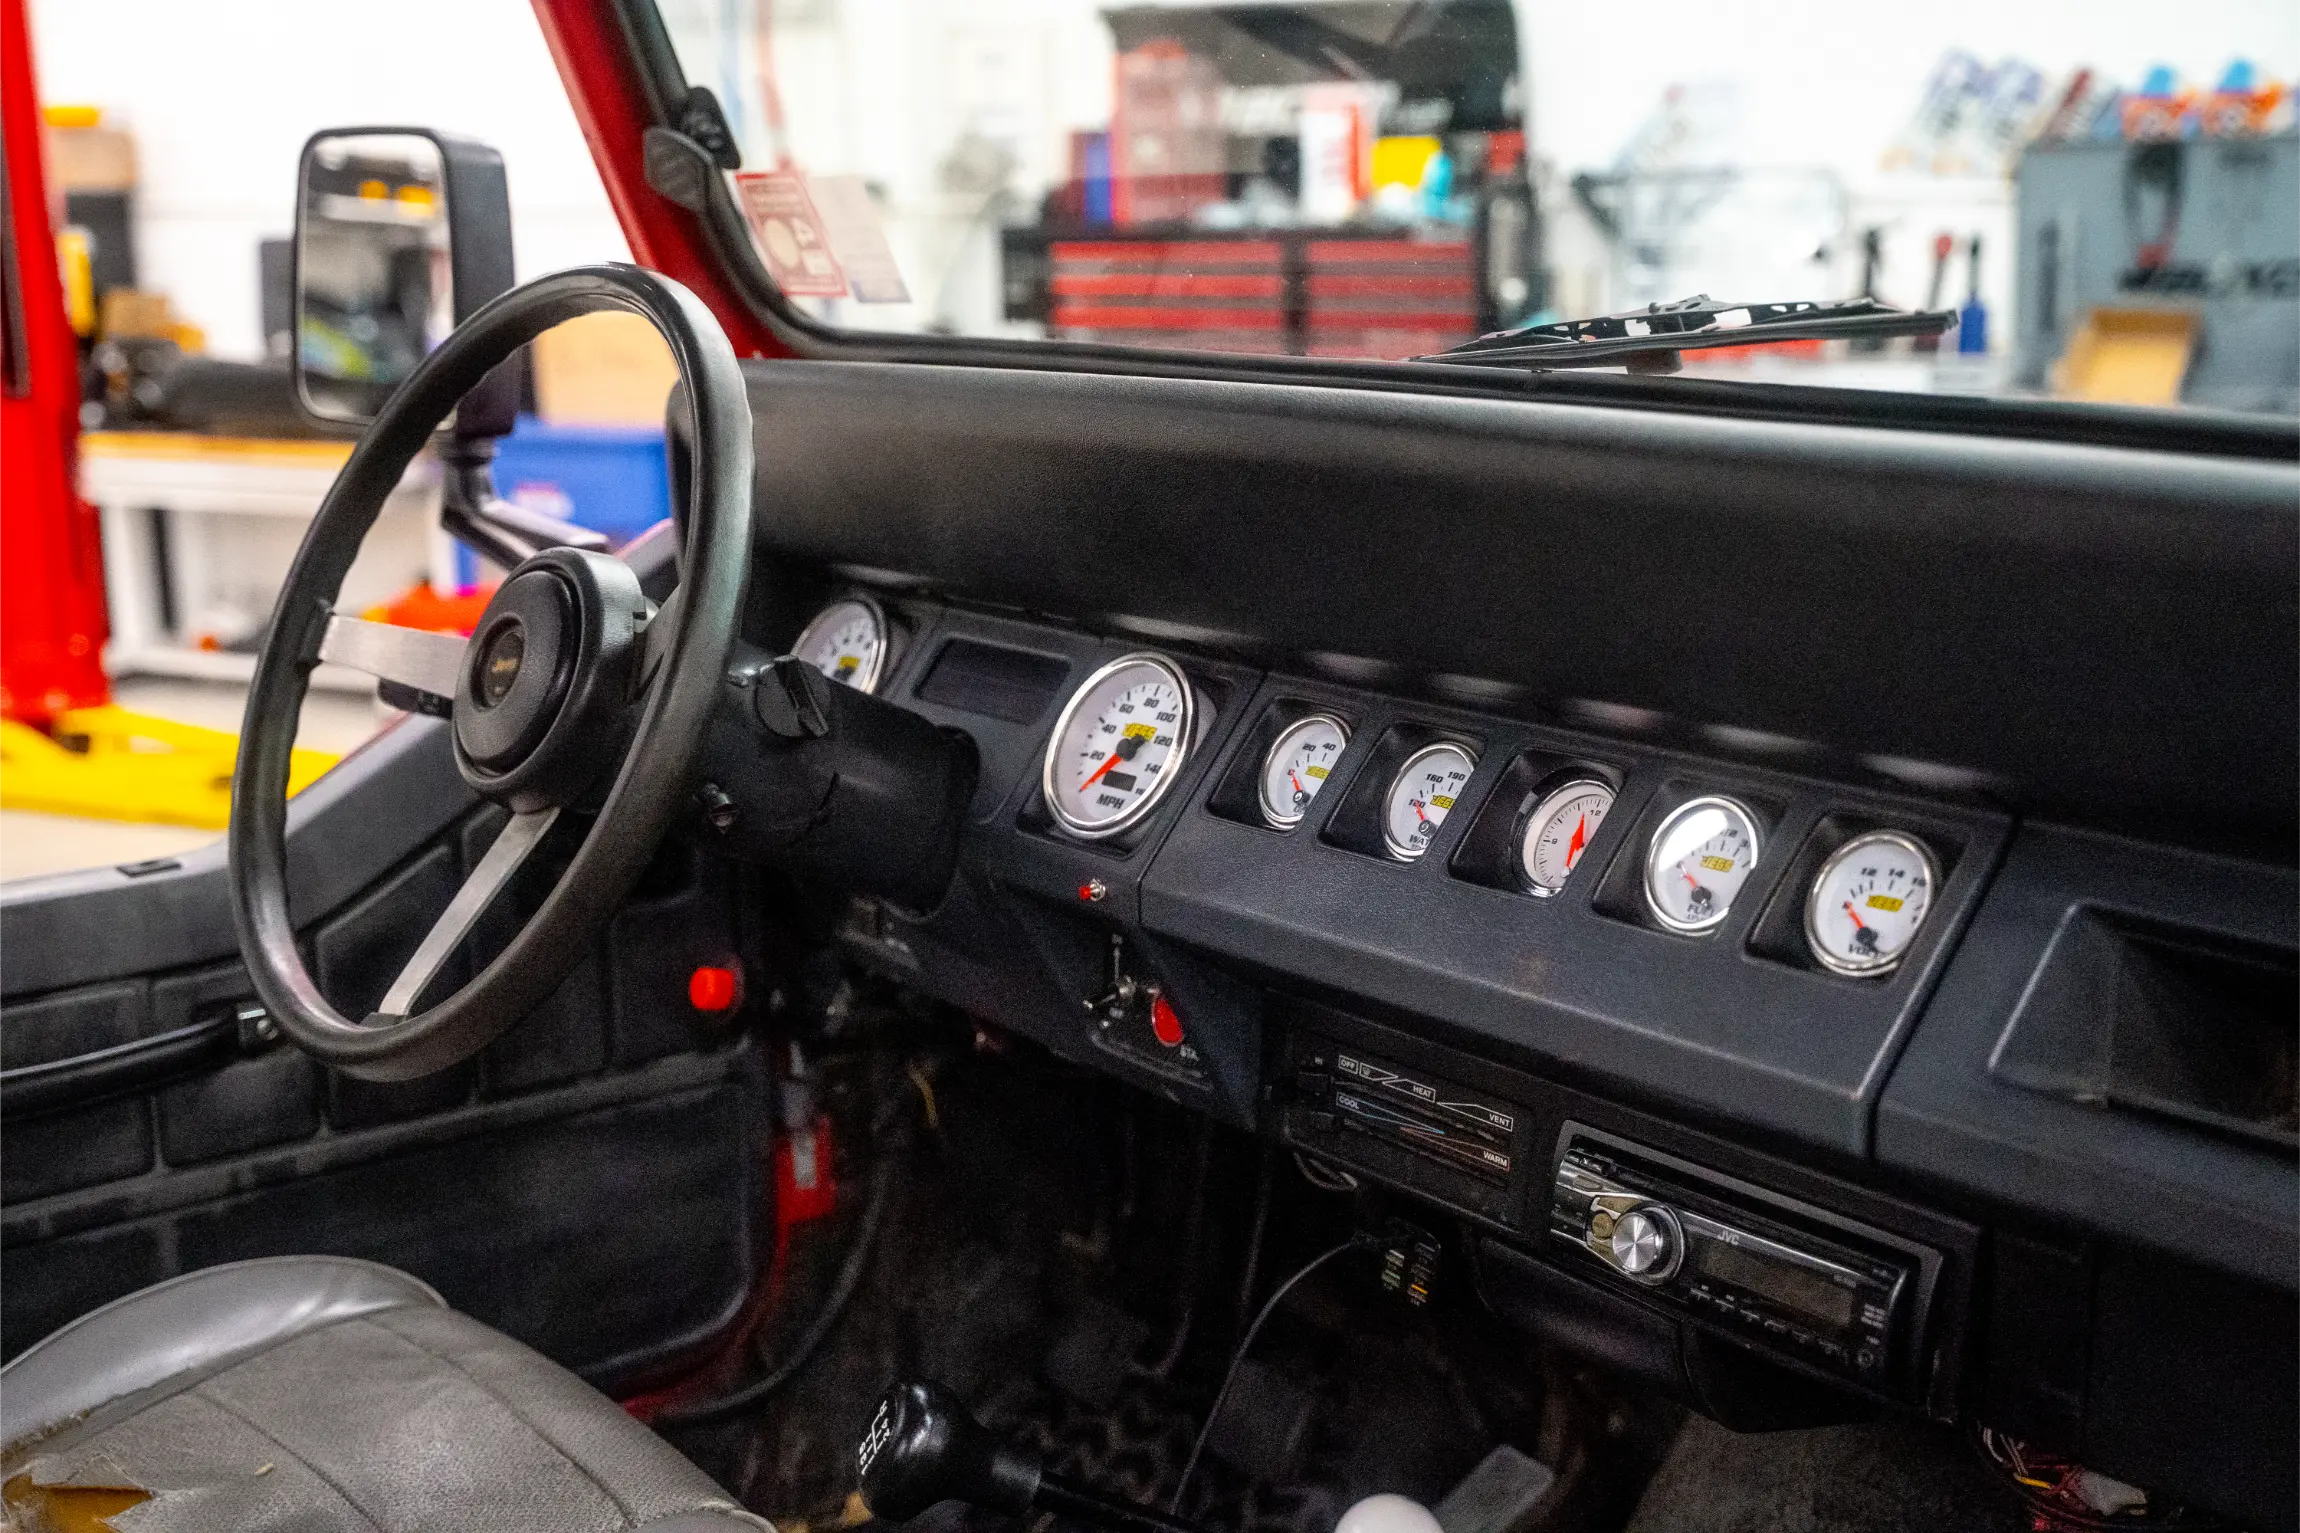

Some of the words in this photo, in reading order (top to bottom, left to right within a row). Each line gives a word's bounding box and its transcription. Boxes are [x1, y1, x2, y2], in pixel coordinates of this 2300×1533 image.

[1119, 703, 1135, 714] 60
[1143, 697, 1160, 708] 80
[1156, 711, 1176, 723] 100
[1102, 724, 1117, 735] 40
[1153, 735, 1174, 747] 120
[1322, 742, 1337, 751] 40
[1302, 743, 1317, 752] 20
[1089, 748, 1106, 761] 20
[1425, 773, 1444, 783] 160
[1447, 771, 1466, 781] 190
[1096, 794, 1126, 810] MPH
[1340, 1058, 1355, 1070] OFF
[1413, 1084, 1432, 1098] HEAT
[1339, 1095, 1360, 1110] COOL
[1489, 1113, 1510, 1127] VENT
[1483, 1150, 1507, 1167] WARM
[1716, 1230, 1740, 1246] JVC
